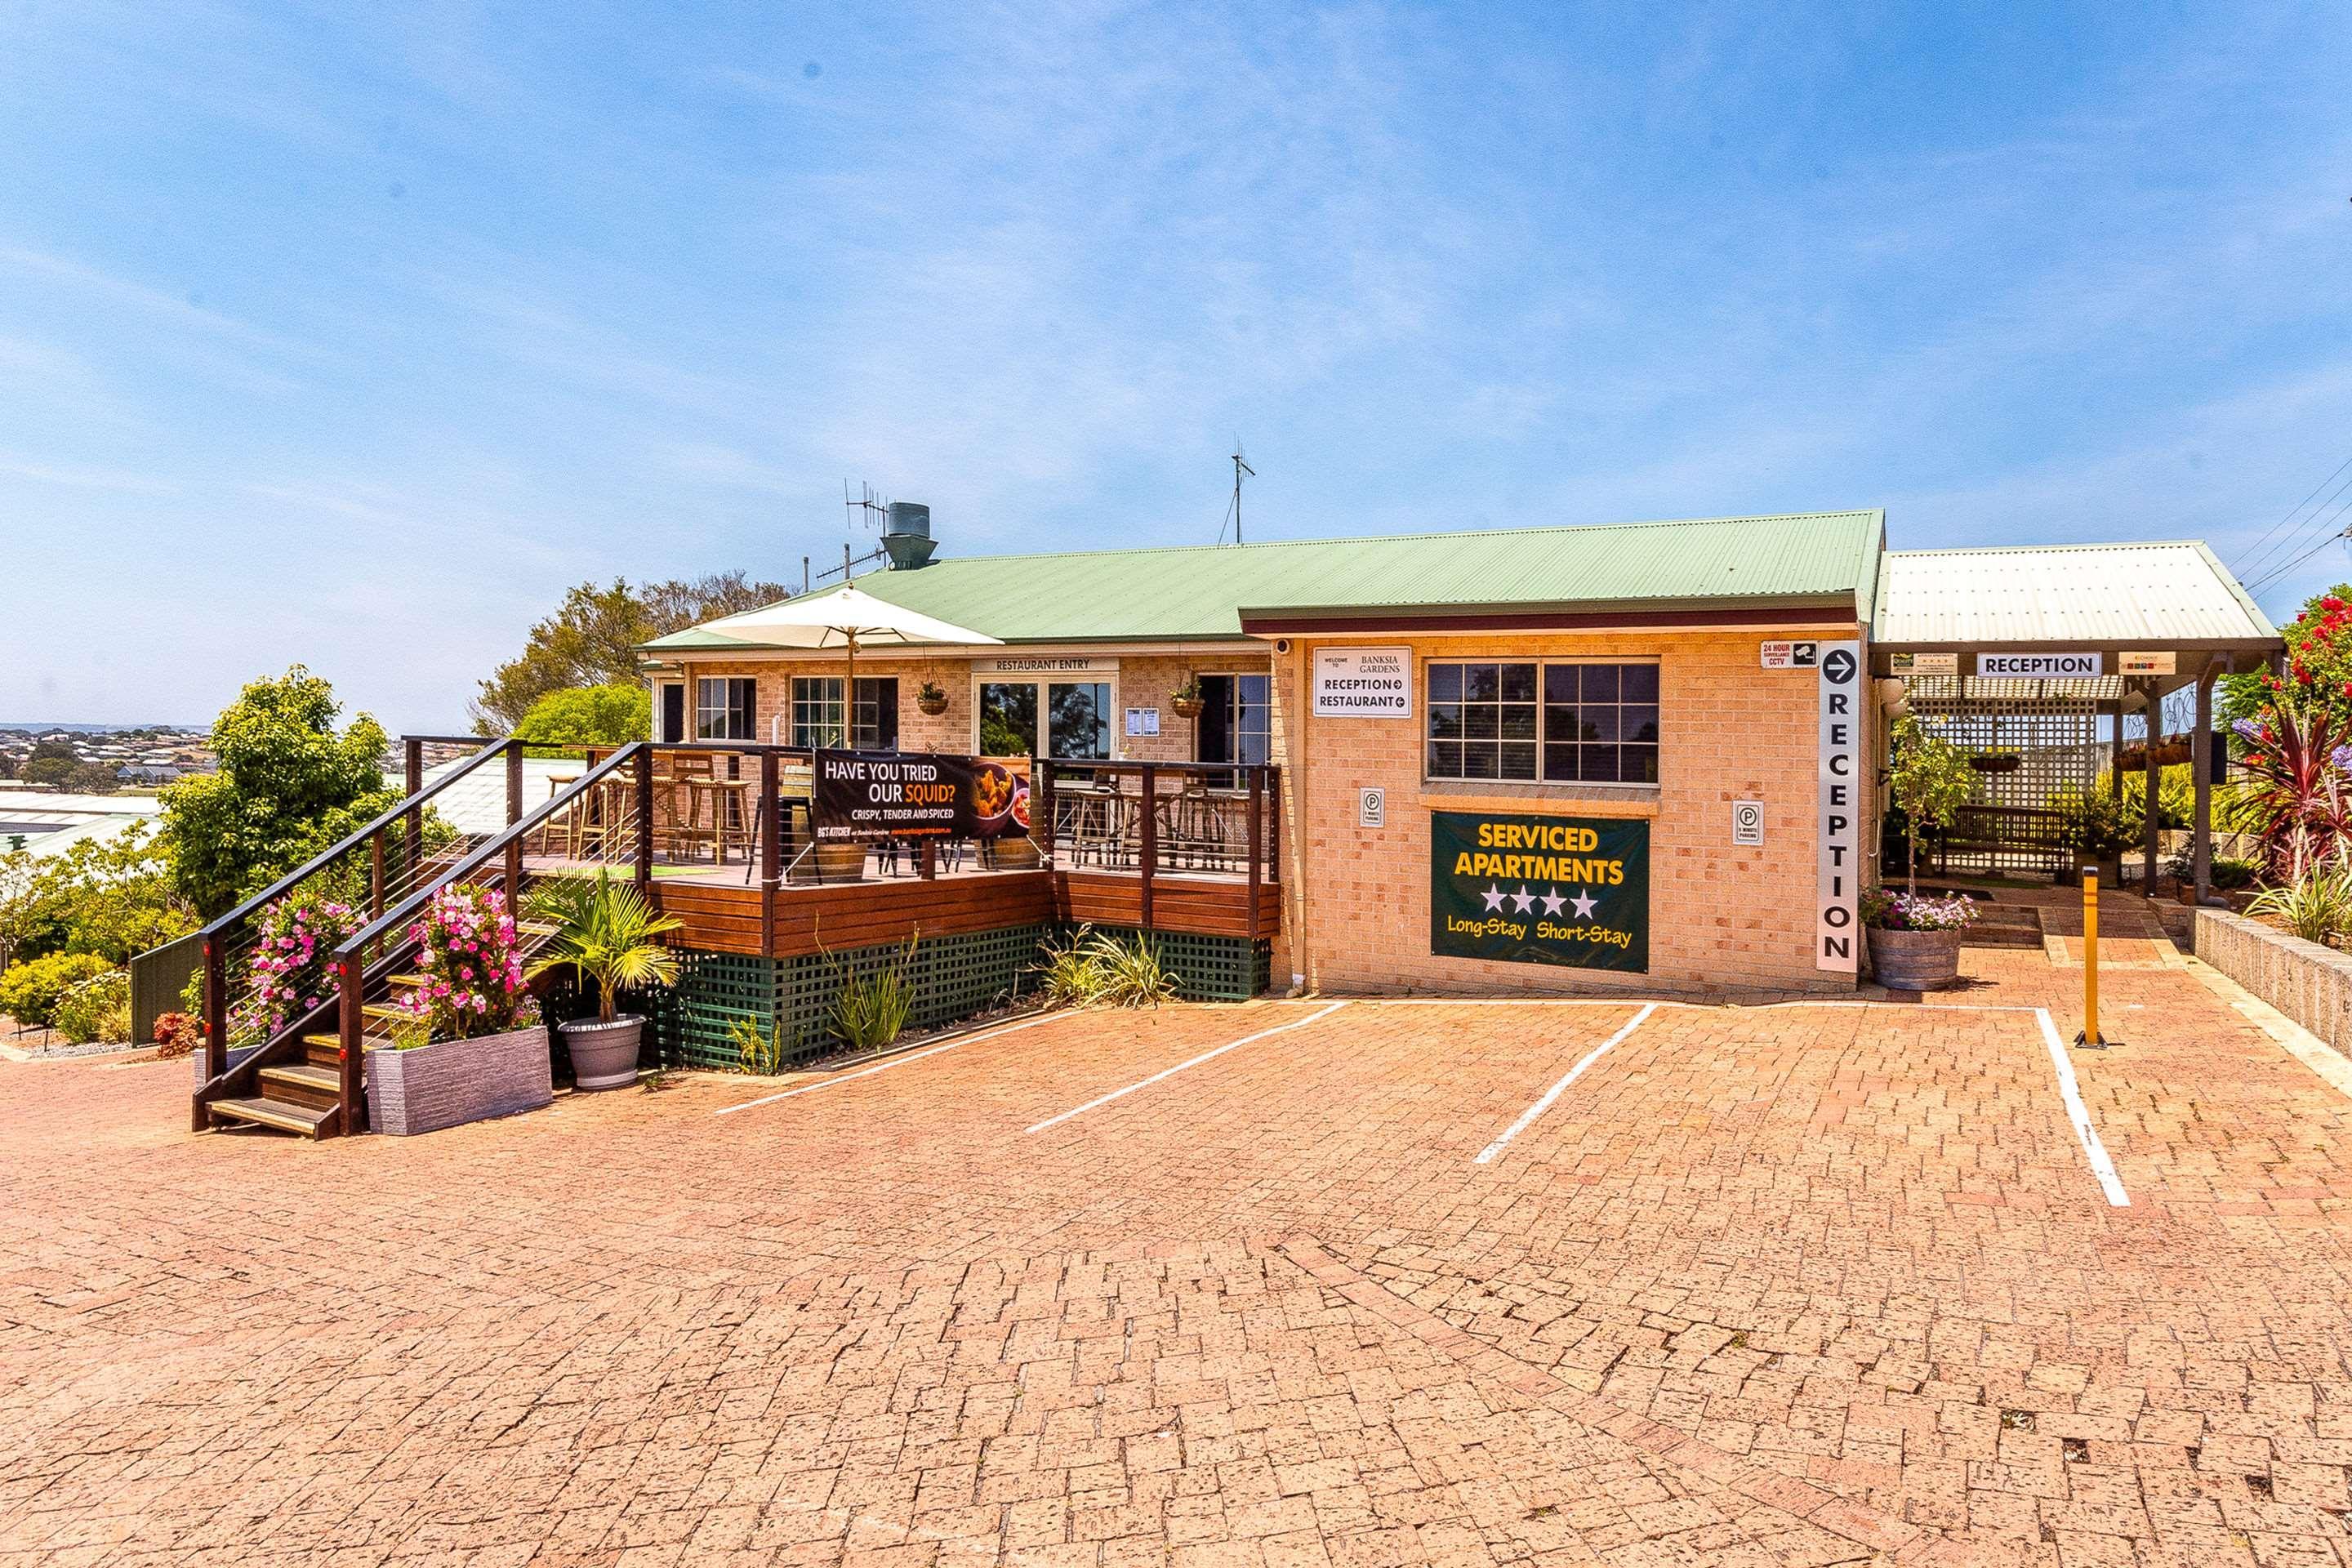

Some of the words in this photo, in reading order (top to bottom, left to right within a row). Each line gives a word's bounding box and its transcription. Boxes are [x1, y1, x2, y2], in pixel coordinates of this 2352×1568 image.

[996, 659, 1057, 670] RESTAURANT
[1059, 659, 1090, 670] ENTRY
[1361, 656, 1398, 664] BANKSIA
[1769, 657, 1784, 666] CCTV
[1986, 657, 2093, 673] RECEPTION
[1359, 665, 1401, 674] GARDENS
[1325, 679, 1392, 690] RECEPTION
[1320, 696, 1393, 706] RESTAURANT
[825, 760, 866, 780] HAVE
[868, 763, 899, 781] YOU
[902, 764, 937, 781] TRIED
[869, 784, 902, 803] OUR
[905, 784, 956, 806] SQUID?
[852, 809, 882, 822] CRISPY,
[883, 809, 912, 820] TENDER
[913, 809, 928, 819] AND
[929, 808, 954, 819] SPICED
[1744, 811, 1753, 822] P
[1824, 693, 1851, 959] RECEPTION
[1478, 823, 1598, 852] SERVICED
[1454, 852, 1624, 885] APARTMENTS
[1448, 915, 1526, 941] Long-Stay
[1536, 921, 1632, 949] Short-Stay
